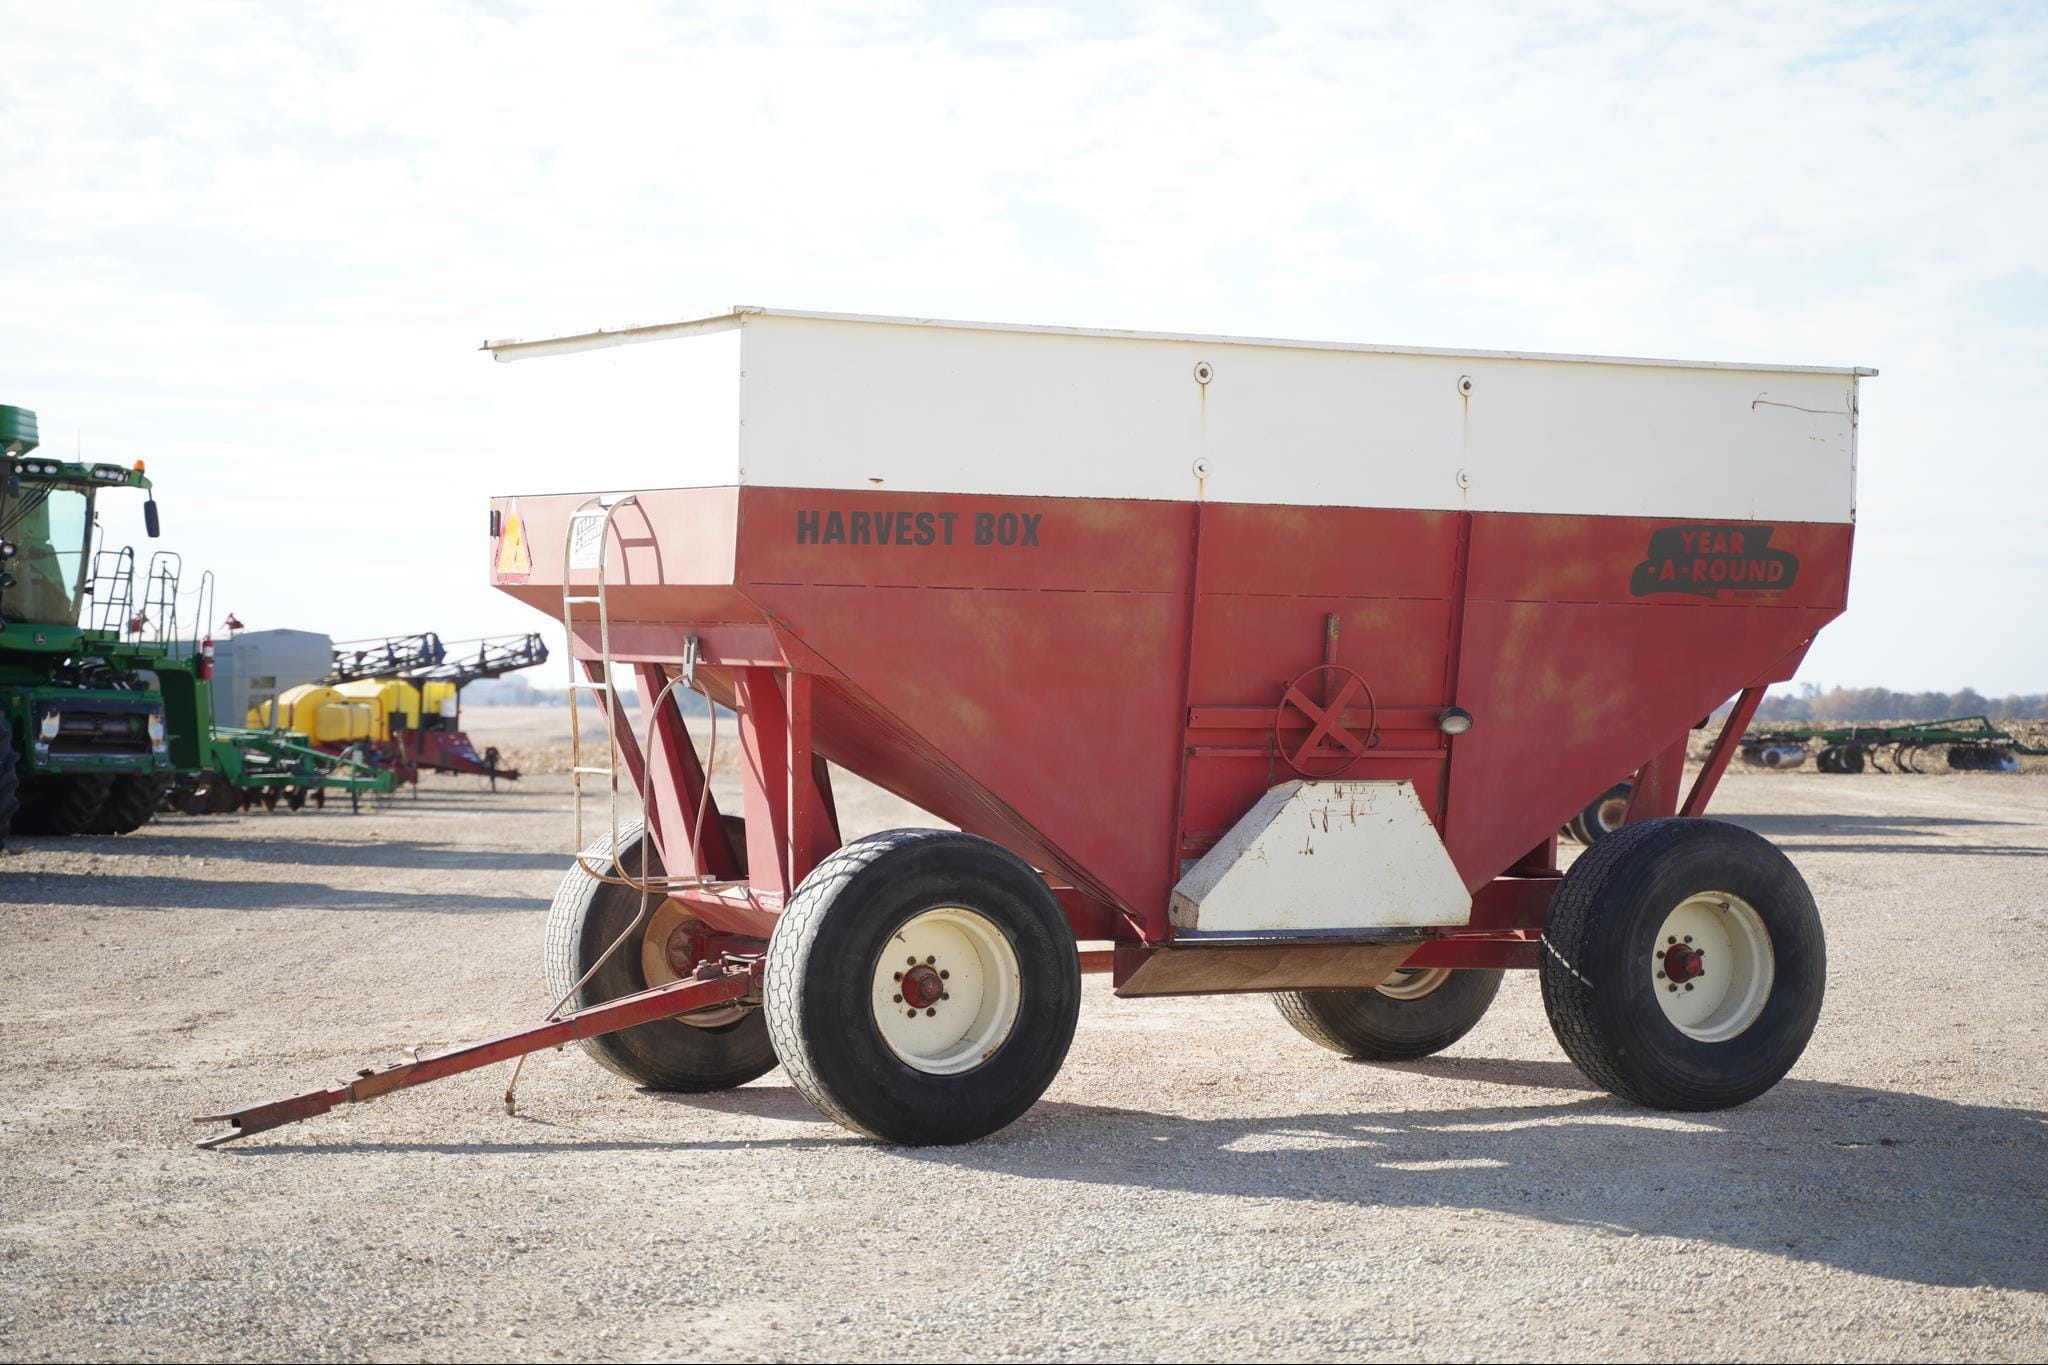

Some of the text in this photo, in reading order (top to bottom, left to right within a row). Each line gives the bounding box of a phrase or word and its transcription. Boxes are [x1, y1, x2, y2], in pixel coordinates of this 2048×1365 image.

[797, 510, 1042, 547] HARVEST BOX
[1680, 531, 1745, 555] YEAR
